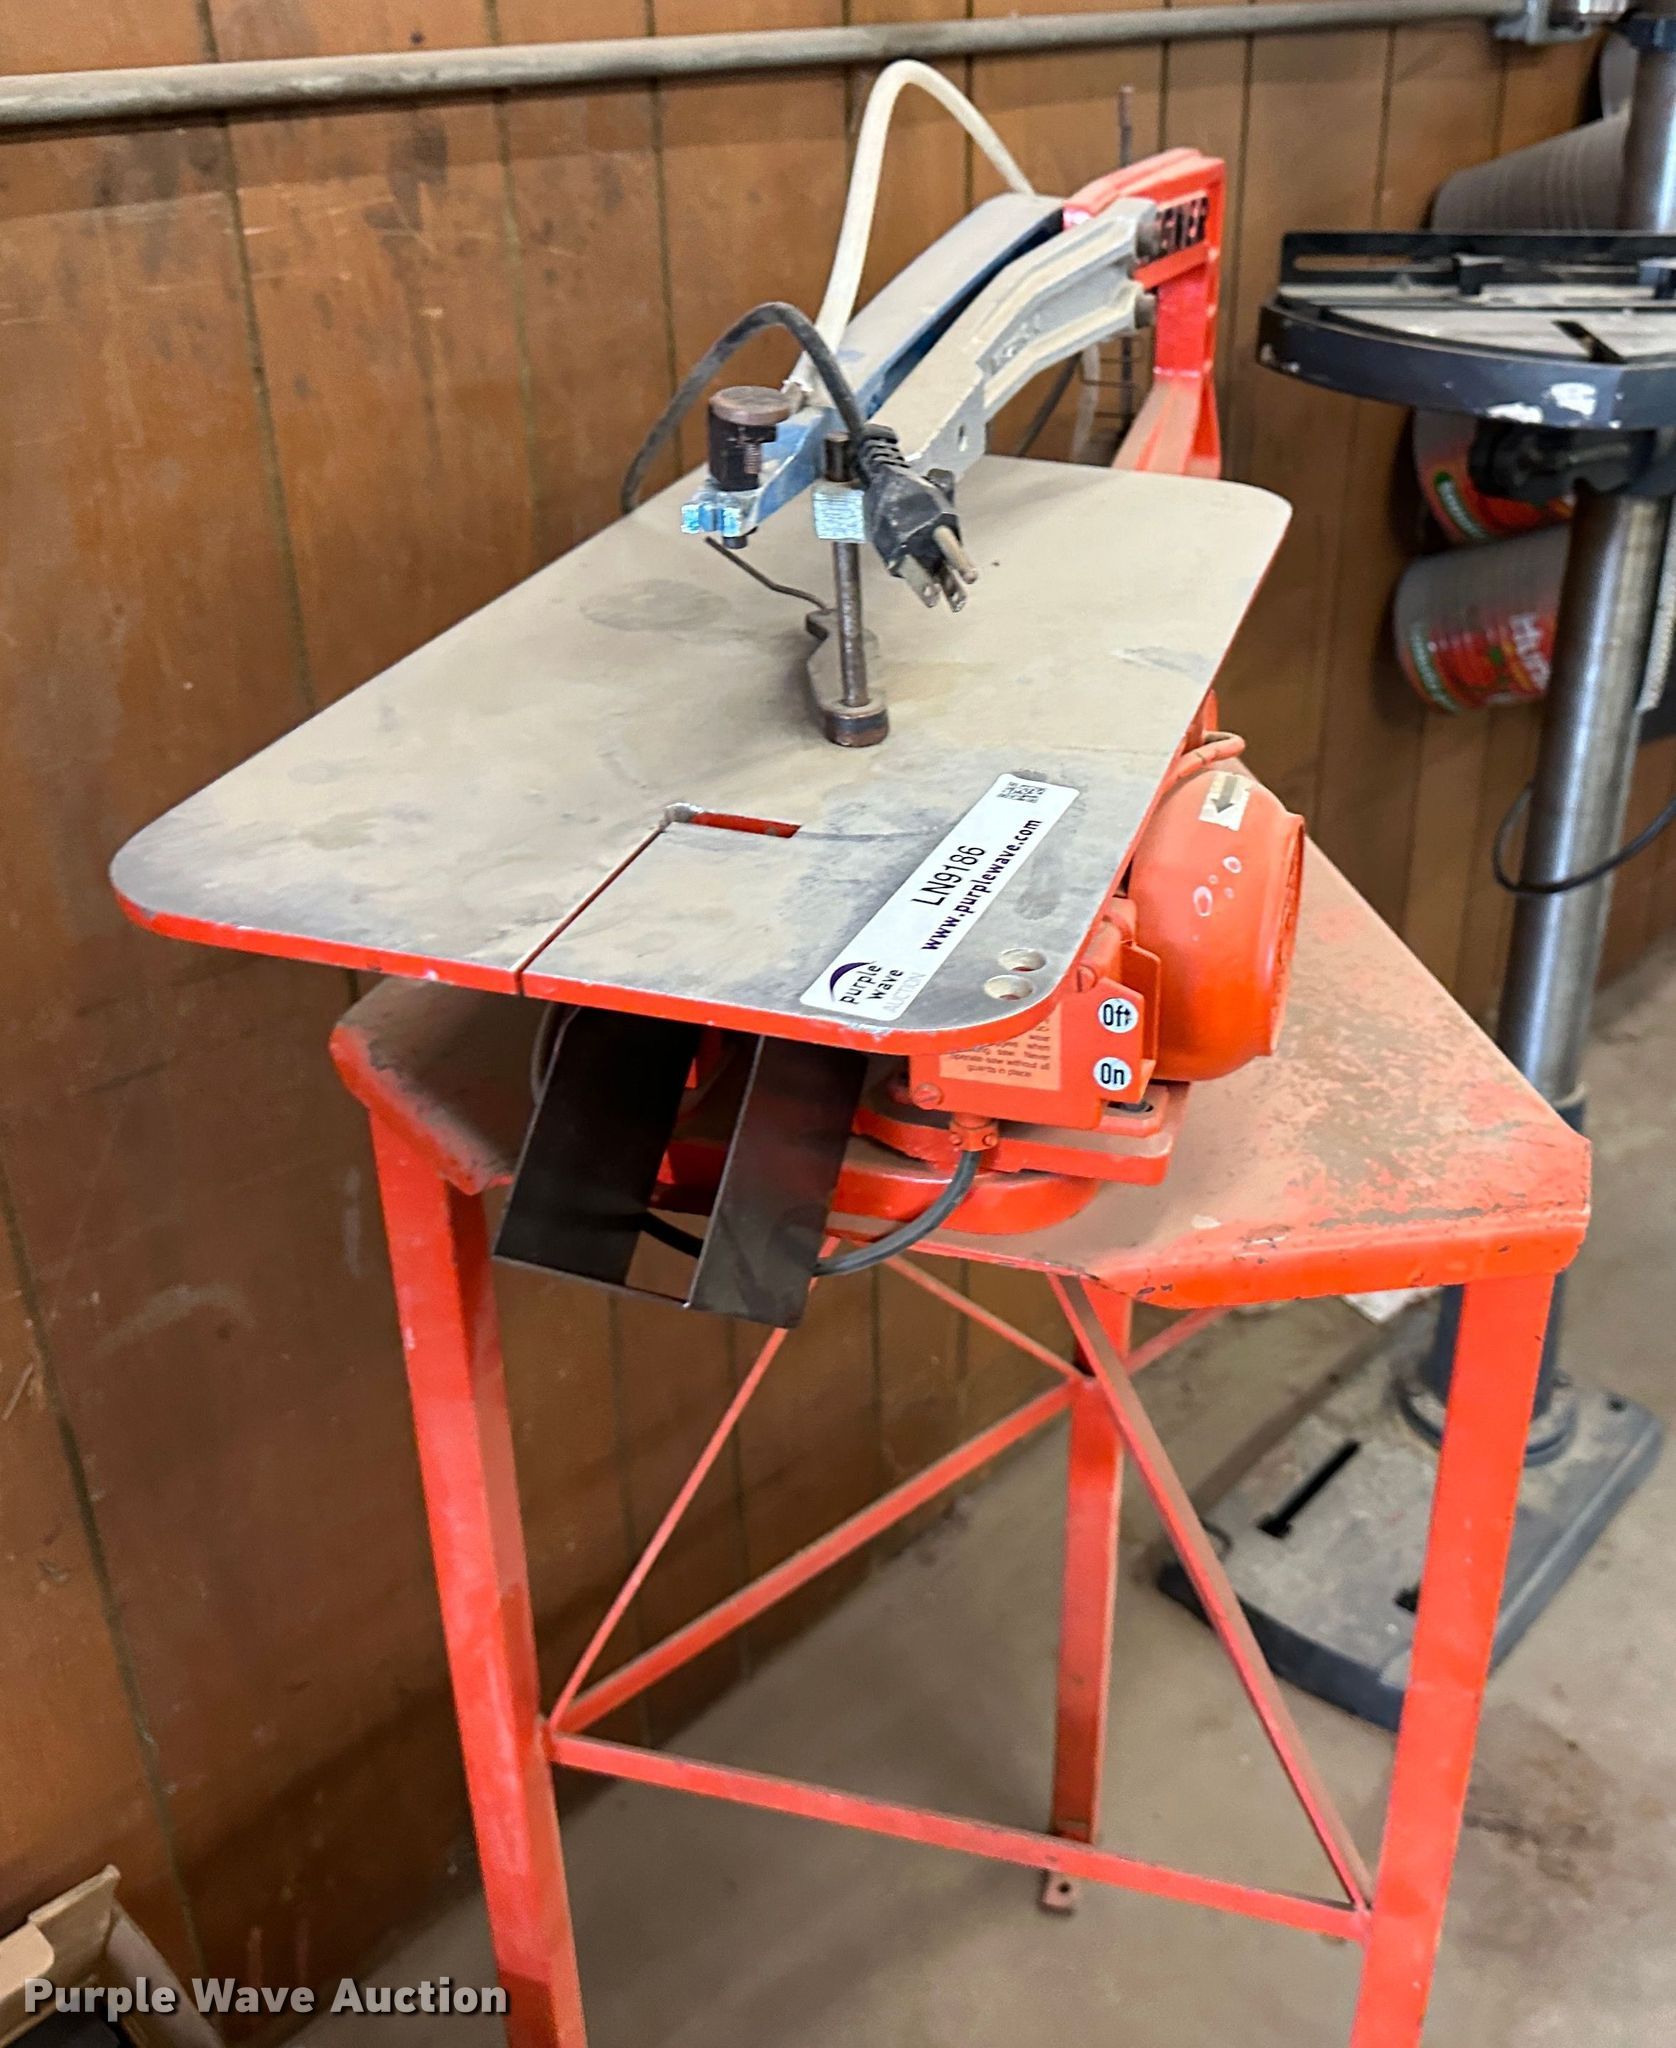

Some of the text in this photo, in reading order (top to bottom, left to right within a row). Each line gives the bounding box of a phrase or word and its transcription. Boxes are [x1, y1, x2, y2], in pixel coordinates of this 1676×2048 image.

[911, 845, 985, 906] LN9186
[921, 819, 1042, 950] www.purplewave.com
[839, 964, 882, 1005] purple
[867, 969, 904, 1000] wave
[1100, 1063, 1125, 1085] On
